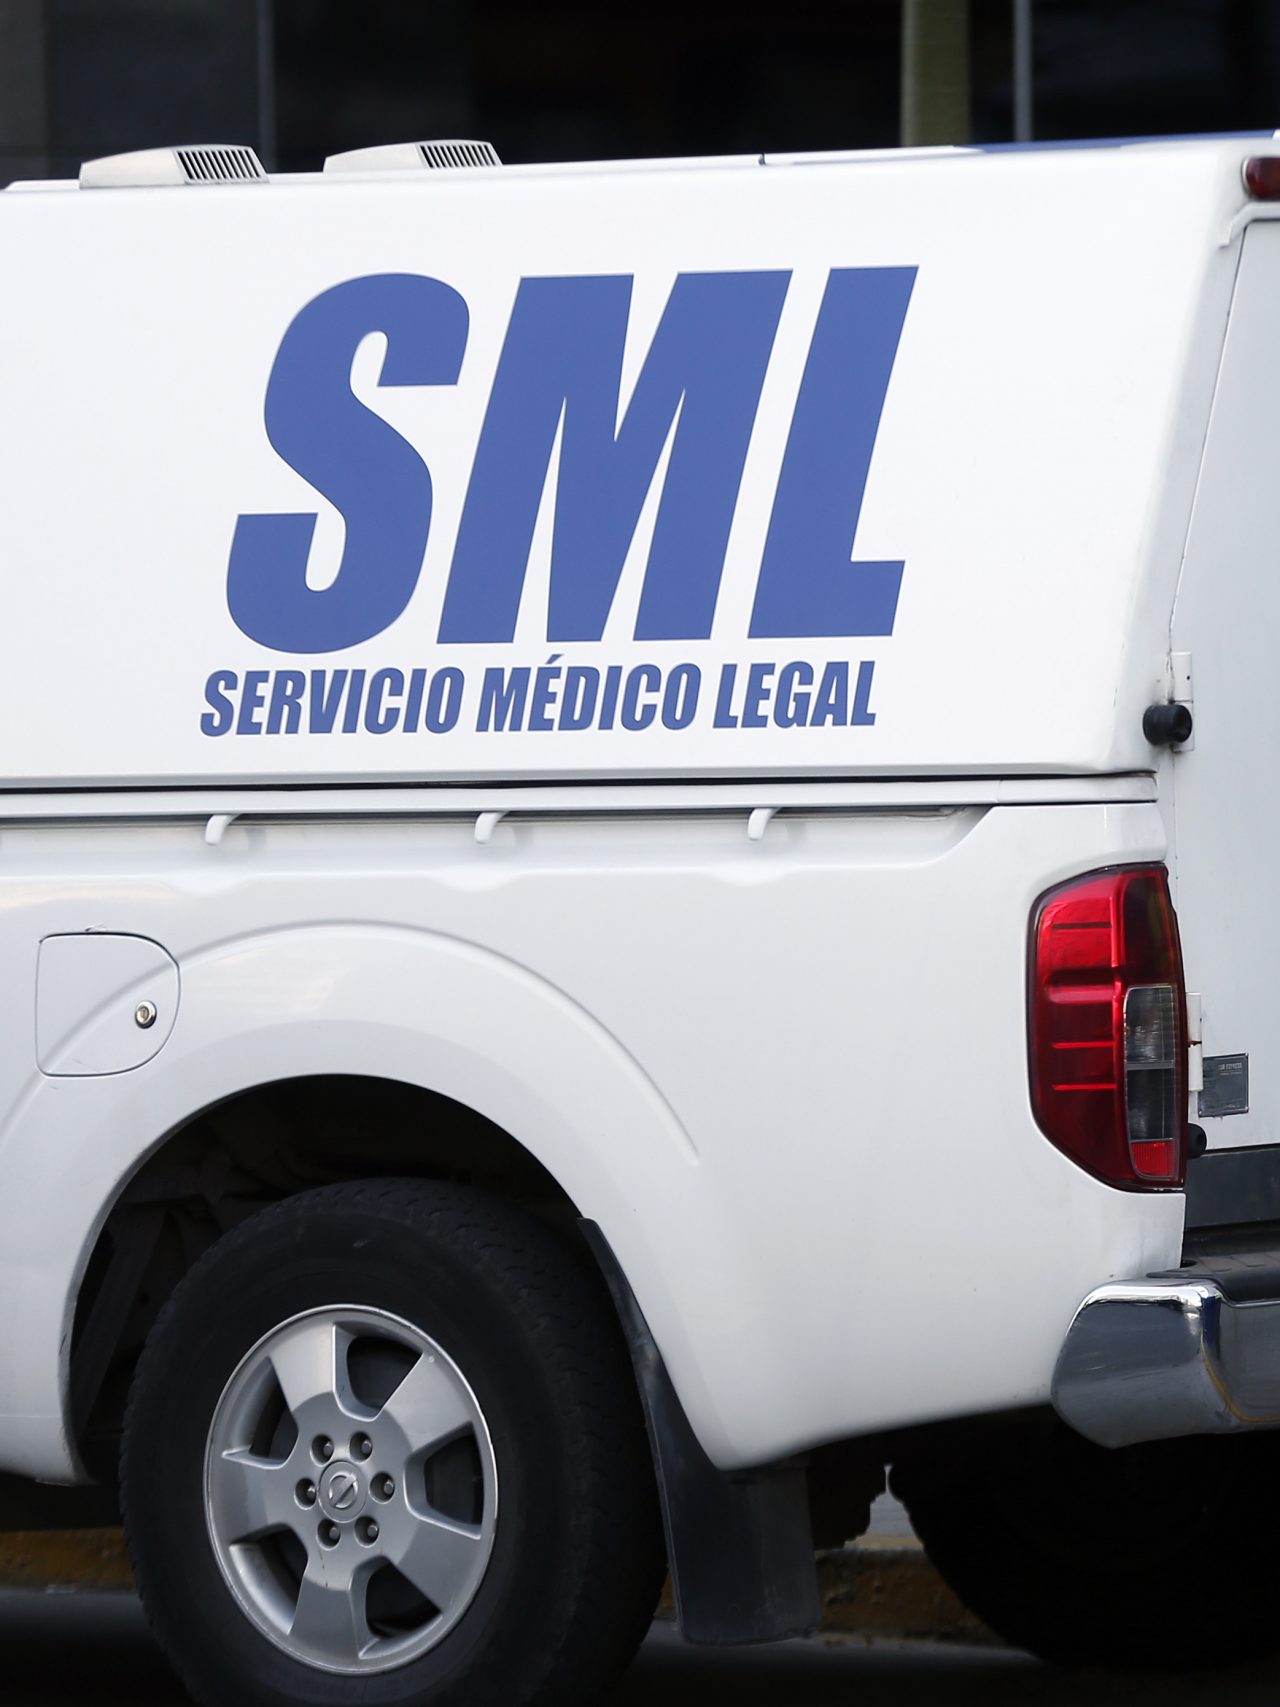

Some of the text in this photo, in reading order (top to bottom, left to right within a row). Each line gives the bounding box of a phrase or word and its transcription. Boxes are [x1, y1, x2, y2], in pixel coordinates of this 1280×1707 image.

[226, 265, 920, 654] SML
[200, 654, 877, 737] SERVICIO MÉDICO LEGAL
